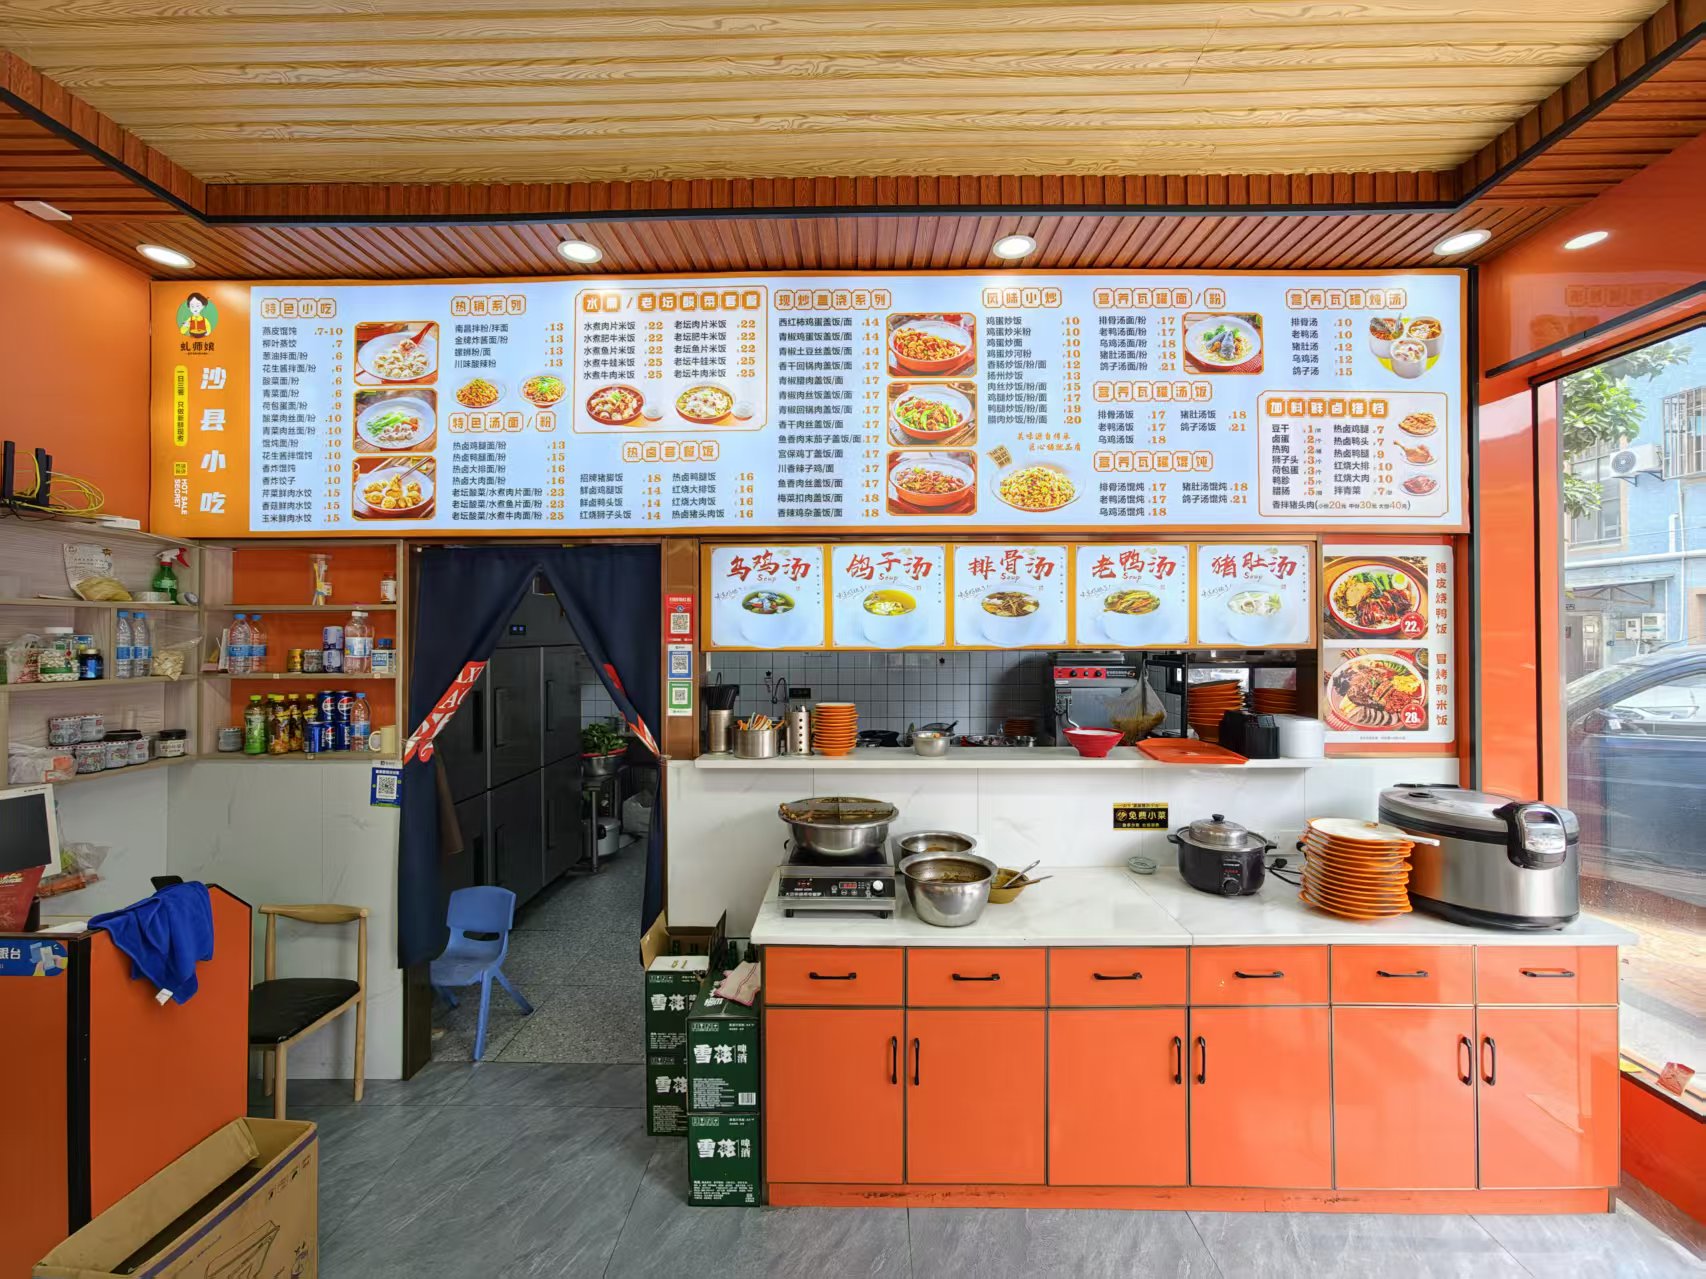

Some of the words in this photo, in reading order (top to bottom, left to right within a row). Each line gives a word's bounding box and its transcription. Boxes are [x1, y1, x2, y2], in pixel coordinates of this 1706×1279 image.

[985, 291, 1058, 305] 风味小炒
[263, 302, 333, 316] 特色小吃
[453, 299, 523, 313] 热销系列
[583, 321, 636, 331] 水煮肉片米饭
[673, 319, 727, 329] 老坛肉片米饭
[986, 316, 1022, 326] 鸡蛋炒饭
[1290, 317, 1319, 327] 排骨汤
[673, 331, 727, 342] 老坛肥牛米饭
[986, 327, 1032, 337] 鸡蛋炒米粉
[1291, 329, 1319, 339] 老鸭汤
[583, 333, 636, 343] 水煮肥牛米饭
[986, 338, 1023, 348] 鸡蛋炒面
[583, 345, 636, 356] 水煮鱼片米饭
[673, 344, 727, 354] 老坛鱼片米饭
[1291, 341, 1319, 352] 猪肚汤
[583, 358, 635, 368] 水煮牛蛙米饭
[673, 356, 727, 366] 老坛牛蛙米饭
[1292, 354, 1319, 364] 乌鸡汤
[583, 370, 635, 380] 水煮牛肉米饭
[673, 368, 726, 378] 老坛牛肉米饭
[1292, 366, 1320, 376] 鸽子汤
[200, 366, 227, 514] 沙县小吃
[726, 549, 812, 582] 乌鸡汤
[846, 551, 934, 581] 鸽子汤
[968, 549, 1055, 581] 排骨汤
[1091, 549, 1176, 580] 老鸭汤
[1211, 551, 1298, 580] 猪肚汤
[878, 573, 899, 583] Soup
[1122, 573, 1143, 583] Soup
[1435, 562, 1448, 635] 脆皮烧鸭饭
[1435, 653, 1448, 726] 冒烤鸭米饭
[1128, 810, 1167, 821] 免费小菜
[693, 1043, 734, 1065] 雪花
[697, 1138, 737, 1159] 雪花
